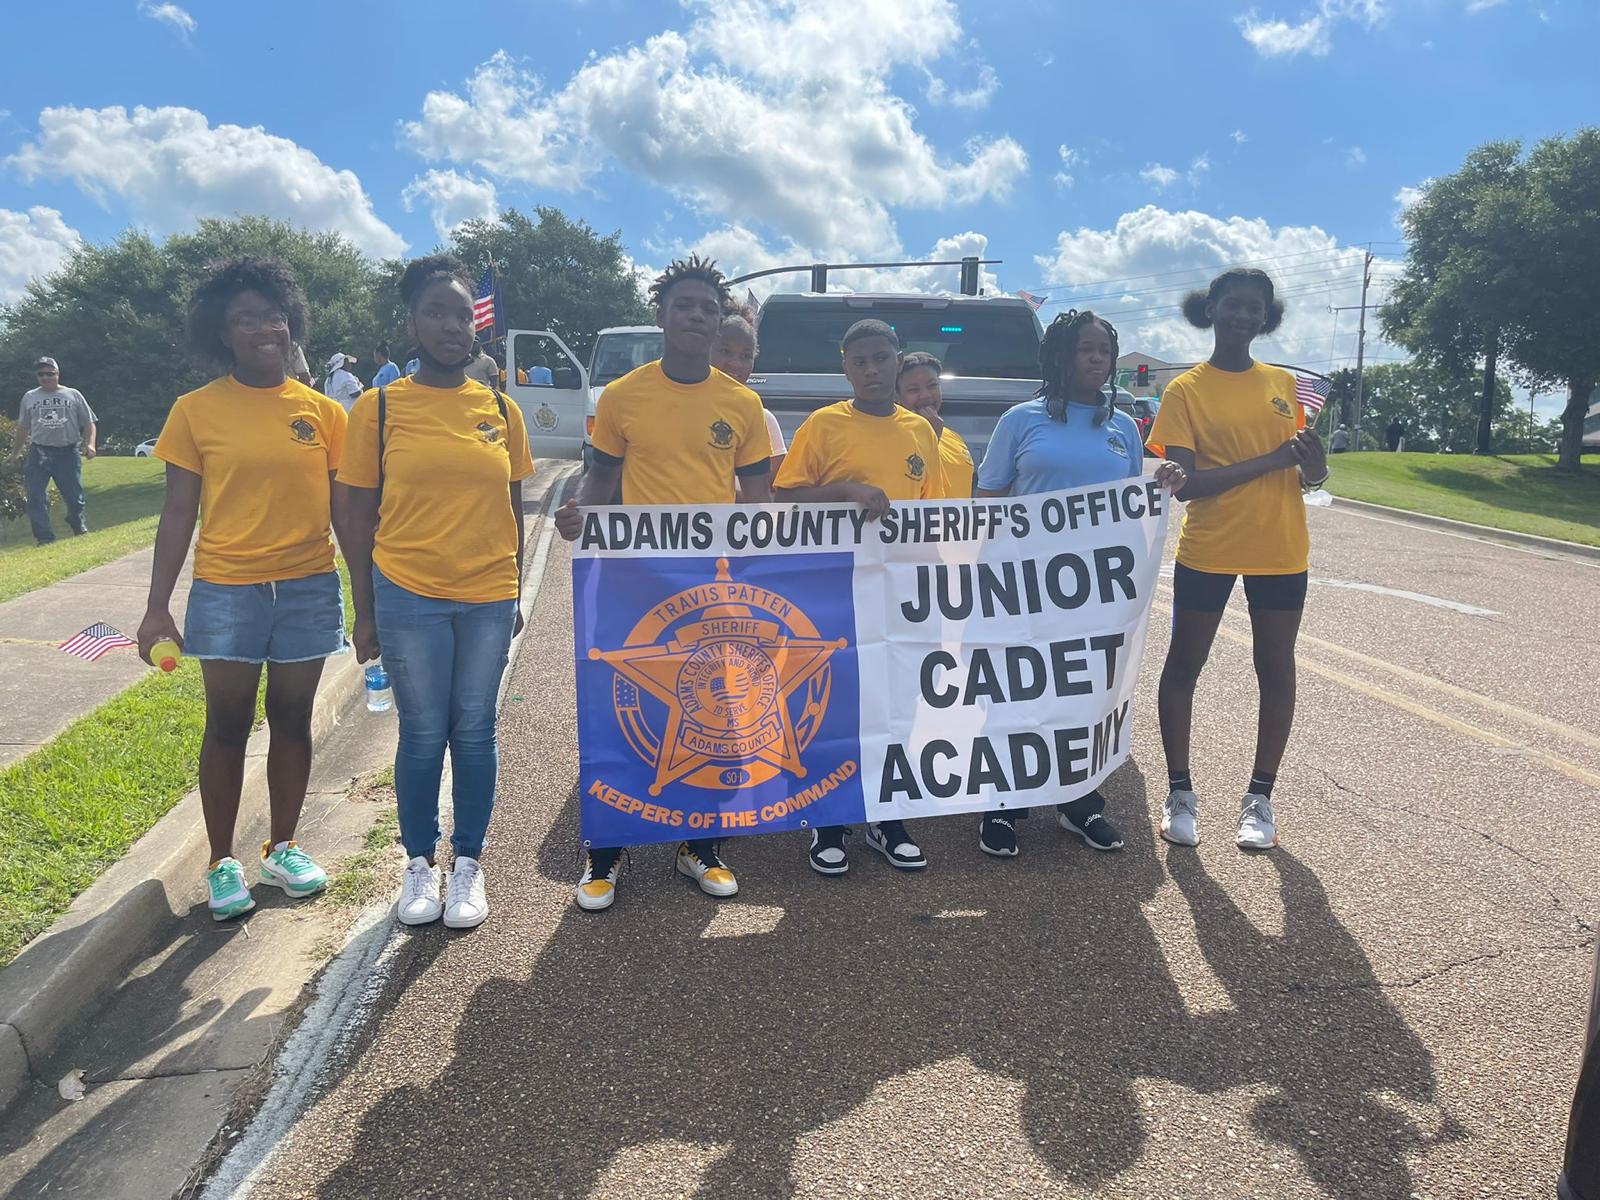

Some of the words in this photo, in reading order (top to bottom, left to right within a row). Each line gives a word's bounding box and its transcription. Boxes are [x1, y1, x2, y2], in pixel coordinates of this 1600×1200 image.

[581, 512, 713, 550] ADAMS
[726, 508, 869, 550] COUNTY
[879, 503, 1031, 544] SHERIFF'S
[1041, 481, 1163, 533] OFFICE
[900, 545, 1137, 623] JUNIOR
[653, 587, 719, 623] TRAVIS
[727, 586, 792, 618] PATTEN
[702, 621, 760, 636] SHERIFF
[684, 644, 723, 677] COUNTY
[697, 658, 726, 690] INTEGRITY
[729, 658, 744, 668] AND
[920, 632, 1125, 709] CADET
[680, 679, 703, 713] ADAMS
[757, 674, 774, 709] OFFICE
[713, 705, 723, 715] TO
[725, 703, 748, 716] SERVE
[727, 718, 739, 728] MS
[689, 736, 729, 754] ADAMS
[879, 700, 1129, 803] ACADEMY
[588, 779, 684, 827] KEEPERS
[688, 812, 716, 829] OF
[719, 810, 758, 828] THE
[760, 760, 857, 822] COMMAND
